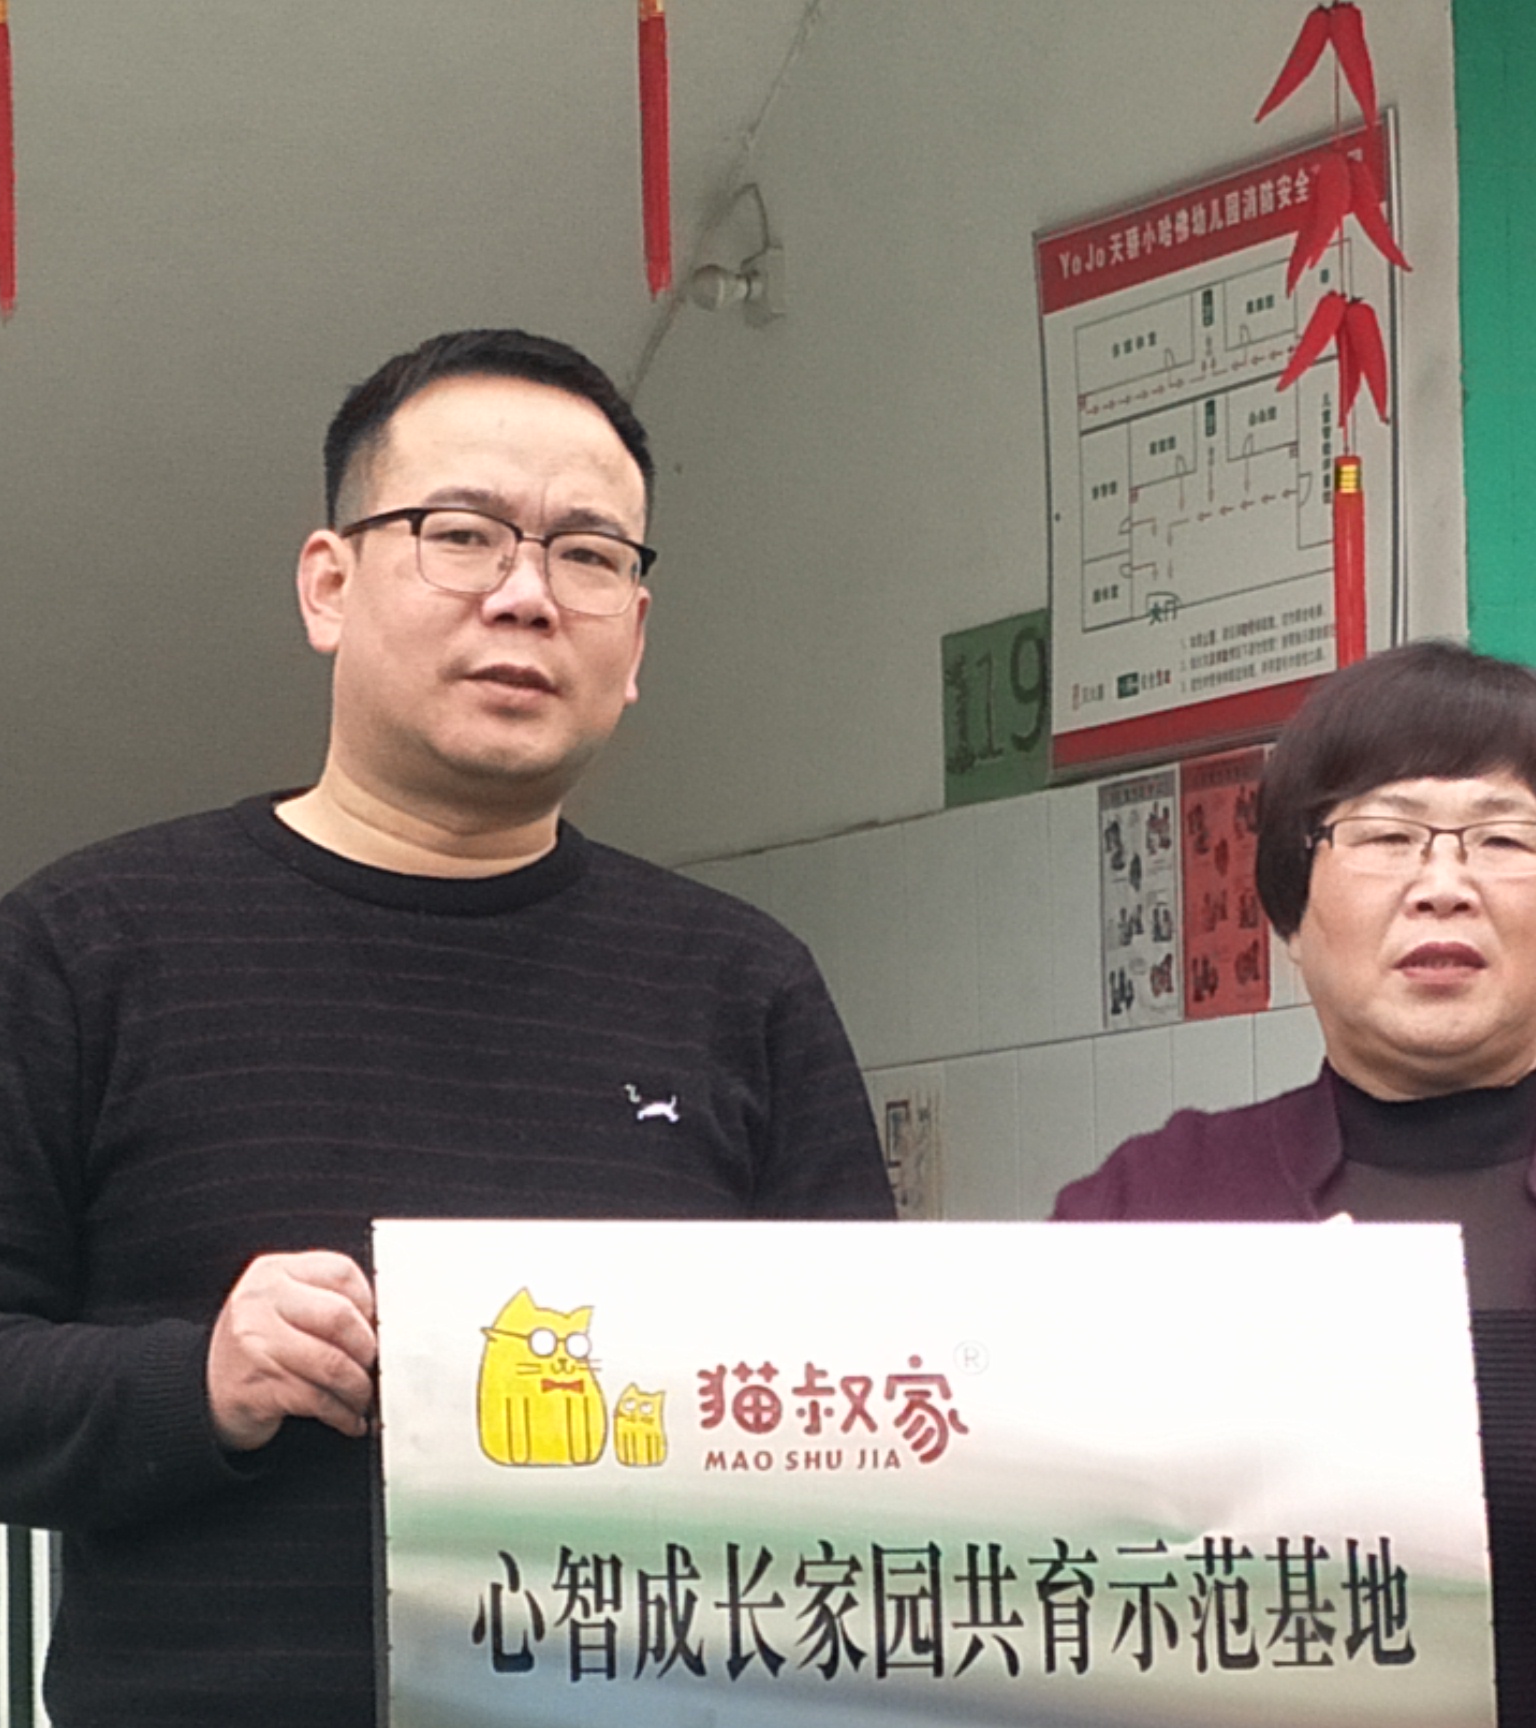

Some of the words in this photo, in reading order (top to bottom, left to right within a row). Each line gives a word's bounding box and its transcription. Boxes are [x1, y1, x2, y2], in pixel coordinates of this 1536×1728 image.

[697, 1354, 969, 1464] 猫叔家
[704, 1450, 773, 1471] MAO
[785, 1449, 842, 1471] SHU
[857, 1448, 901, 1470] JIA
[470, 1535, 1416, 1683] 心智成长家园共育示范基地
